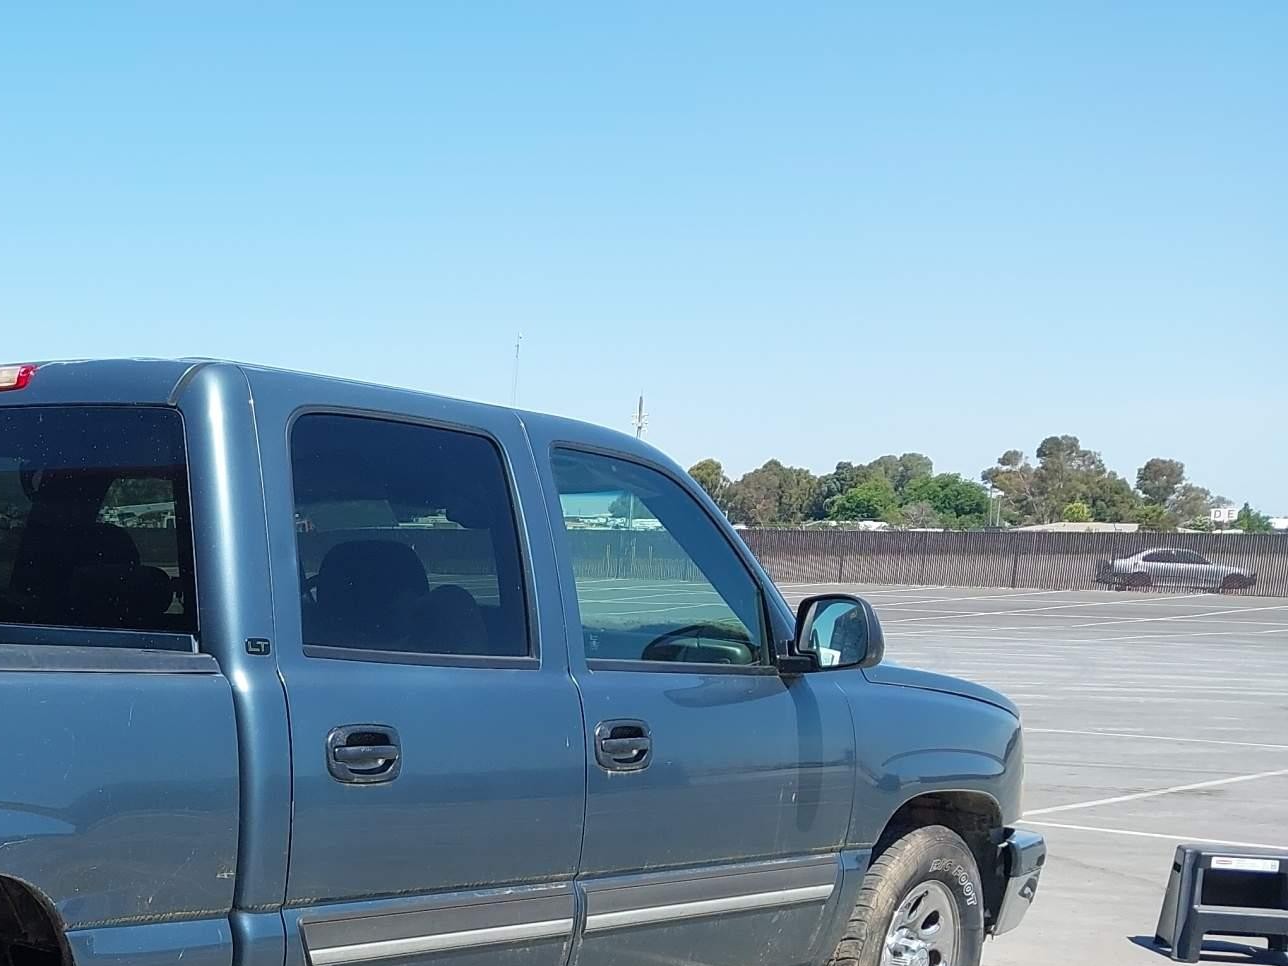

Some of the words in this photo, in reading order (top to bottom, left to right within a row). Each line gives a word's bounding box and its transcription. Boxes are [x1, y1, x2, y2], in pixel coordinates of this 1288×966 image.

[247, 641, 269, 652] LT
[929, 858, 953, 873] BIG
[952, 864, 978, 906] FOOT
